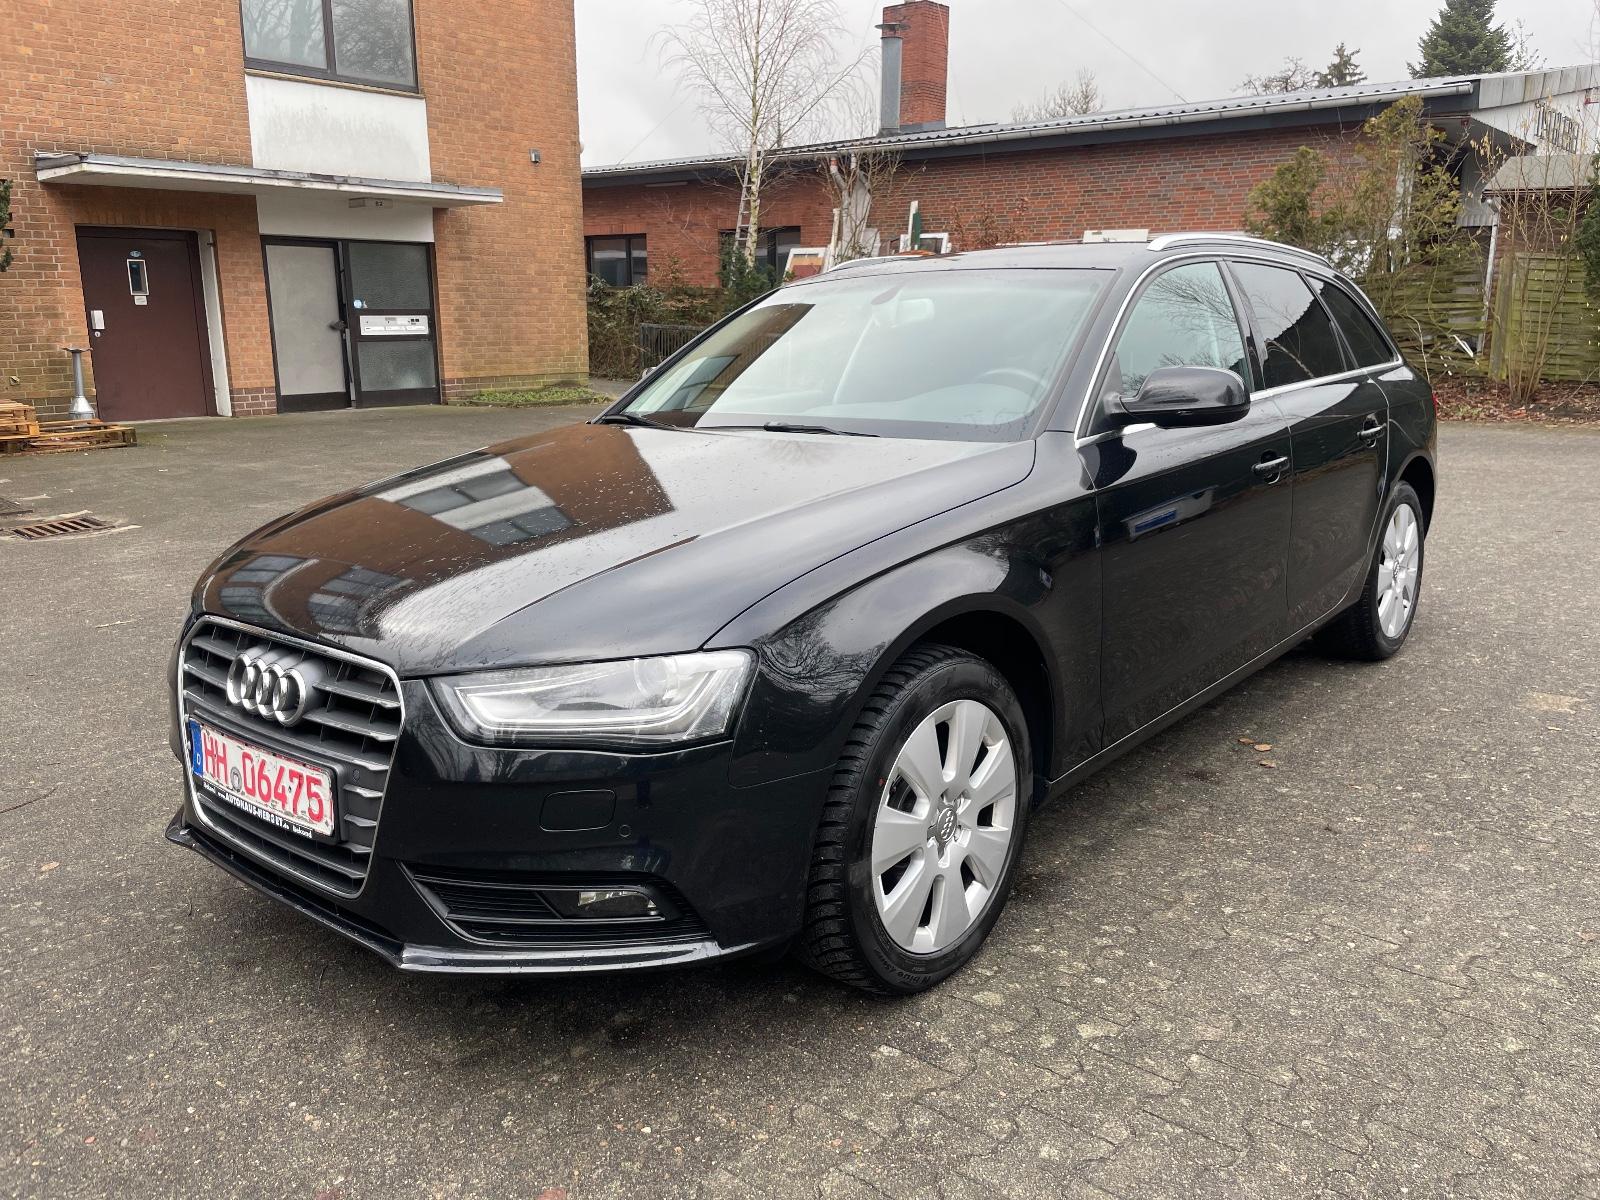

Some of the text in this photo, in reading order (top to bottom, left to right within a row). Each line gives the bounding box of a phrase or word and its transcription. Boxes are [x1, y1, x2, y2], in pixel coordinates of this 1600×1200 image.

[196, 753, 201, 765] D
[203, 733, 324, 822] HH 06475
